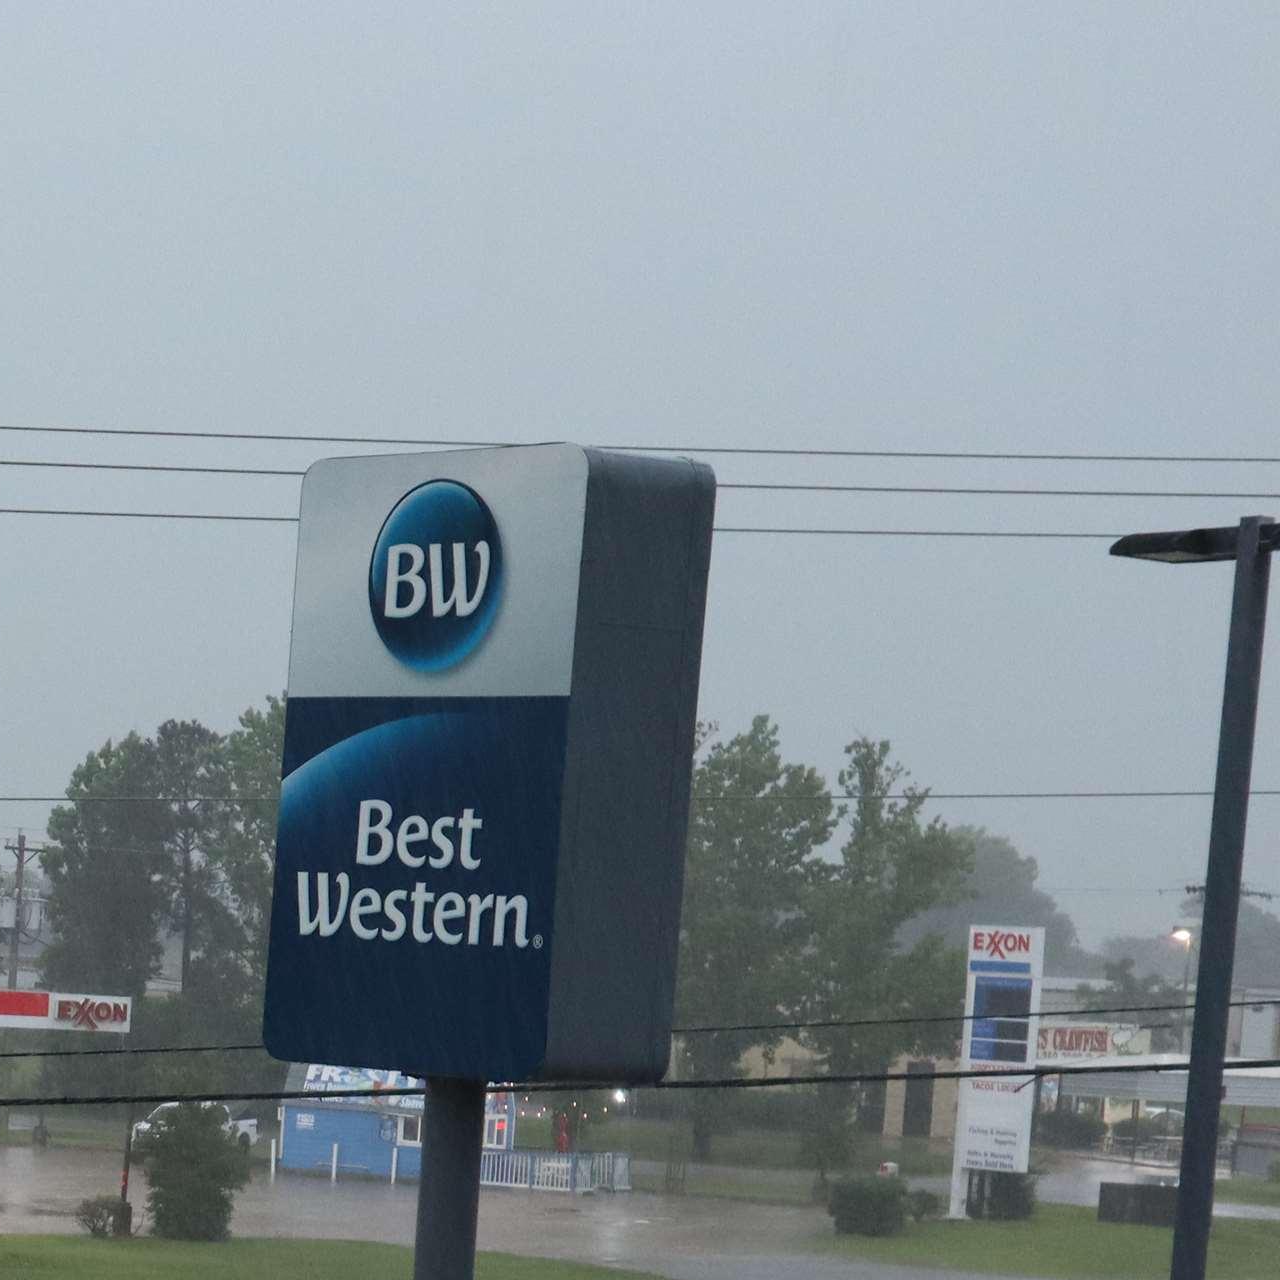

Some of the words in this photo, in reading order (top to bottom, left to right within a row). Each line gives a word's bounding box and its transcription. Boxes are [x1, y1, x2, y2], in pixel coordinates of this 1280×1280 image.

[384, 541, 491, 618] BW
[356, 799, 483, 870] Best
[297, 871, 531, 948] Western
[972, 930, 1030, 959] EXXON
[57, 998, 128, 1030] EXXON
